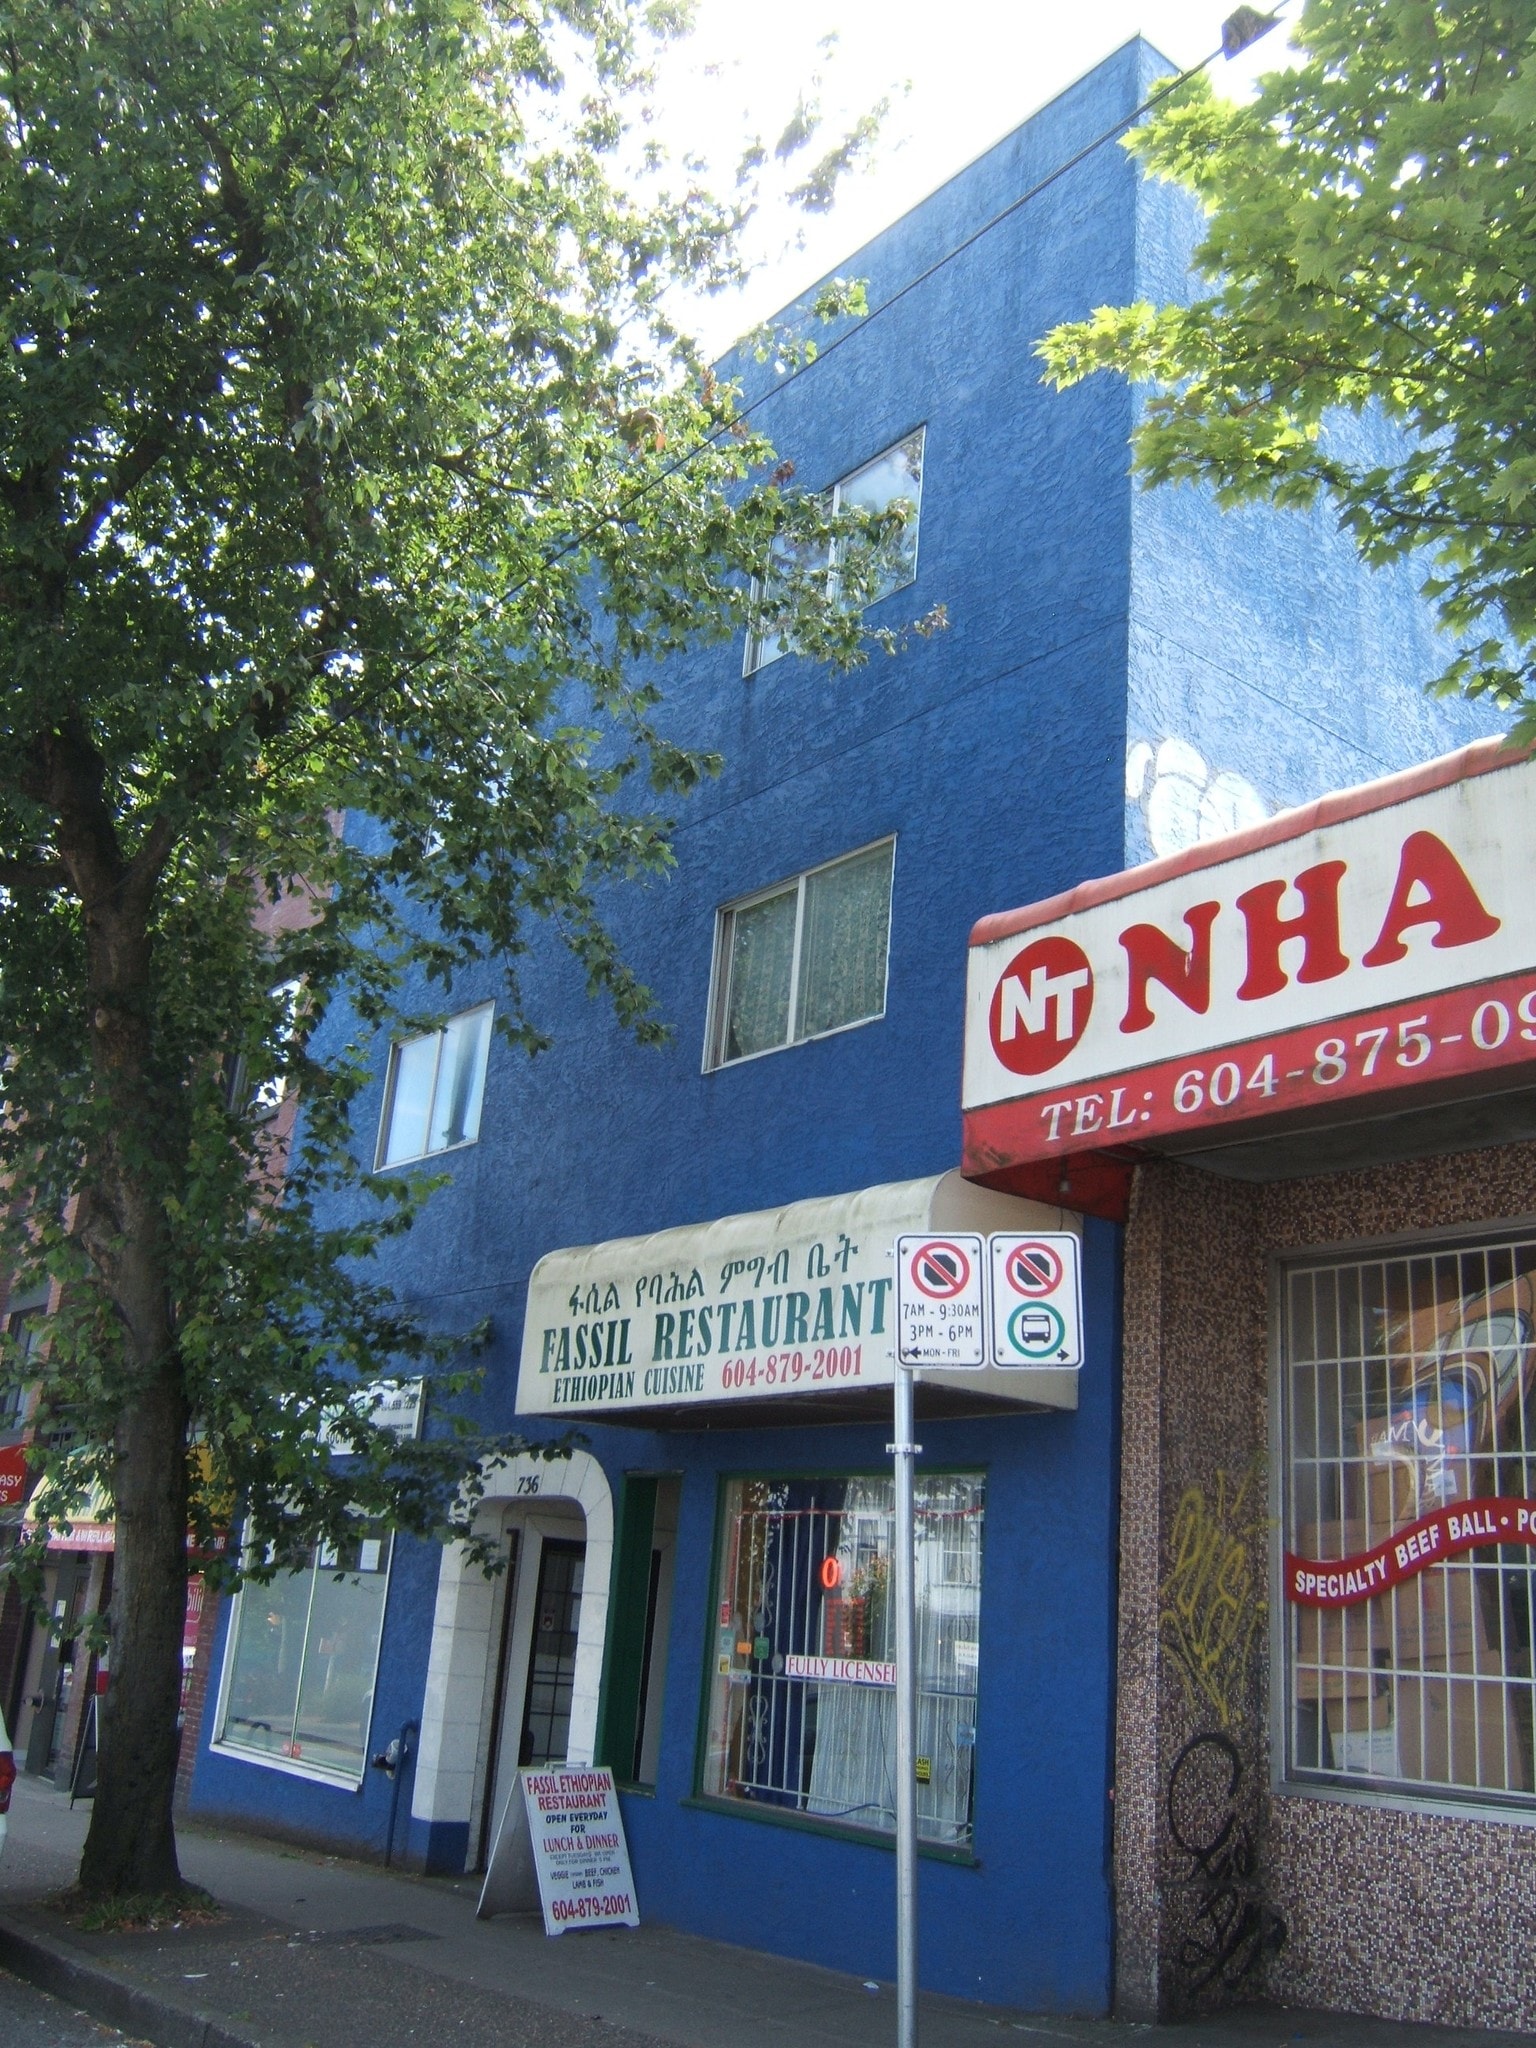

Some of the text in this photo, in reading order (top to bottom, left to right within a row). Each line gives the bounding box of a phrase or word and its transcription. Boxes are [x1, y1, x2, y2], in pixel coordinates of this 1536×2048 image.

[1119, 831, 1502, 1034] NHA
[1000, 966, 1088, 1043] NT
[1041, 1087, 1152, 1142] TEL:
[807, 1234, 859, 1280] ቤት
[903, 1303, 925, 1320] 7AM
[939, 1303, 980, 1321] 9:30AM
[539, 1278, 893, 1374] FASSIL RESTAURANT
[910, 1325, 933, 1341] 3PM
[948, 1325, 973, 1342] 6PM
[553, 1344, 863, 1404] ETHIOPIAN CUISINE 604-879-2001
[517, 1475, 540, 1494] 736
[1295, 1555, 1386, 1598] SPECIALTY
[1394, 1524, 1441, 1570] BEEF
[1447, 1509, 1497, 1541] BALL
[788, 1657, 829, 1677] FULLY
[527, 1773, 611, 1796] FASSIL ETHIOPIAN
[538, 1793, 606, 1811] RESTAURANT
[546, 1811, 608, 1824] OPEN EVERYDAY
[570, 1824, 586, 1834] FOR
[543, 1833, 620, 1853] LUNCH & DINNER
[550, 1870, 569, 1880] VEGGIE
[600, 1866, 621, 1876] CHICKEN
[572, 1879, 587, 1889] LAMB
[593, 1878, 605, 1888] FISH
[552, 1893, 632, 1921] 604-879-2001
